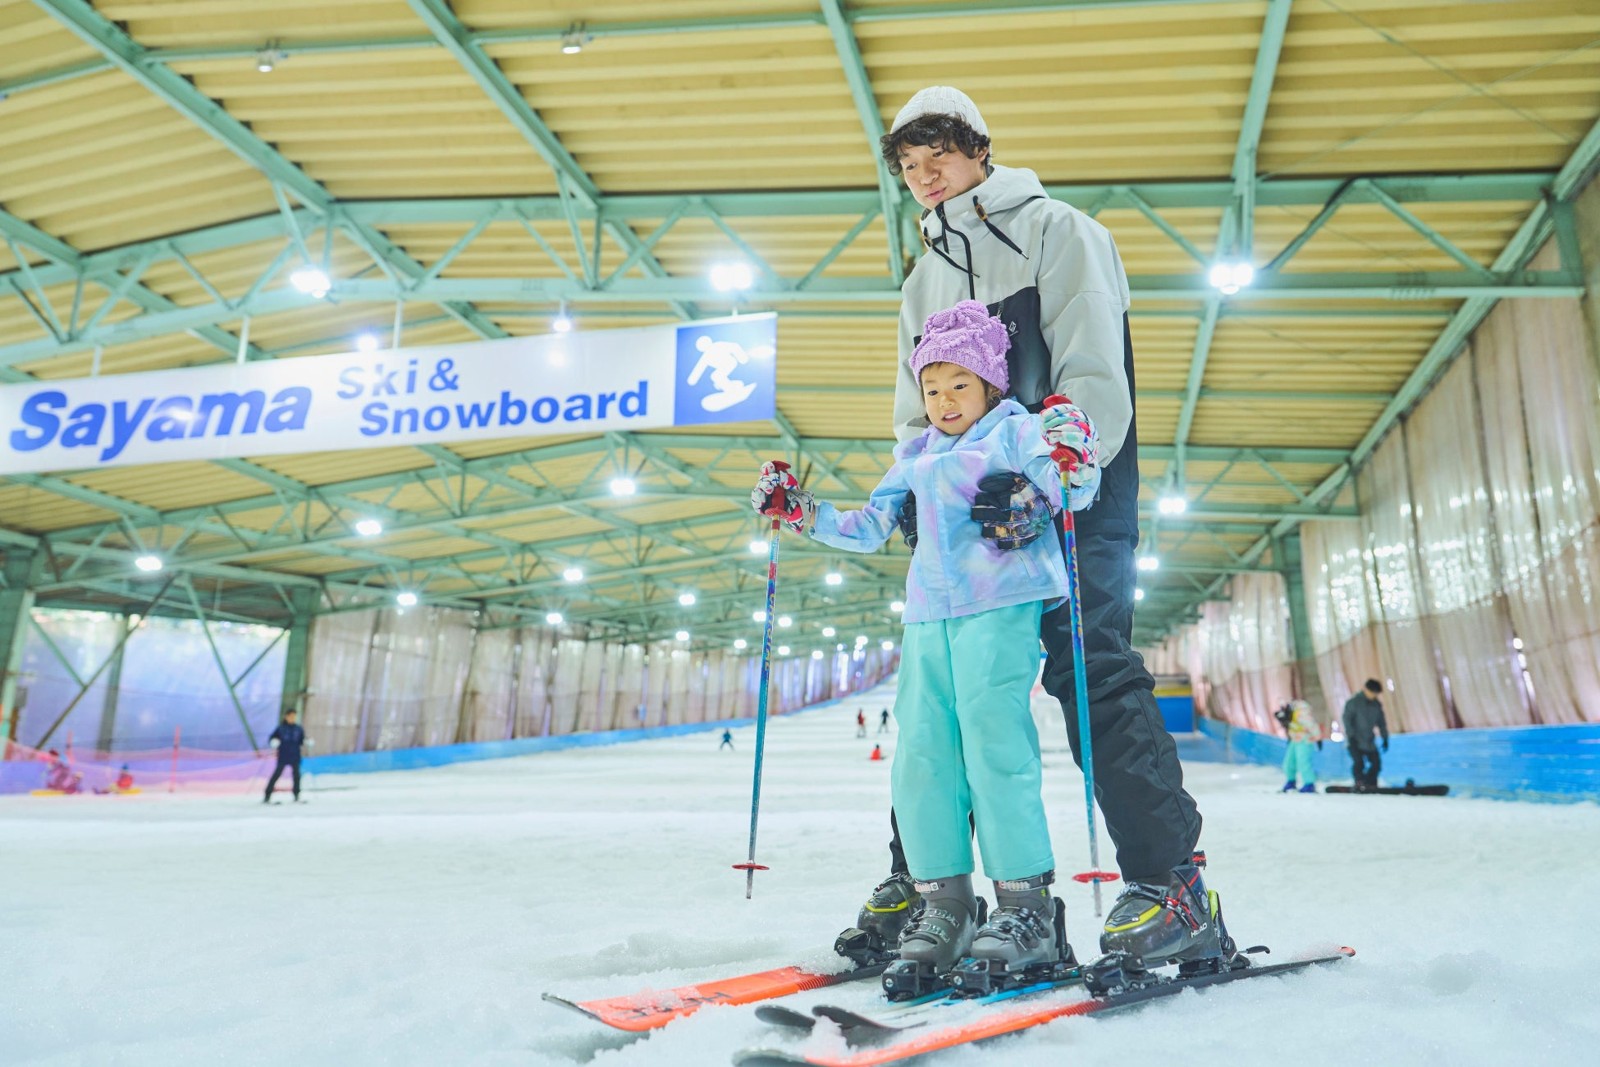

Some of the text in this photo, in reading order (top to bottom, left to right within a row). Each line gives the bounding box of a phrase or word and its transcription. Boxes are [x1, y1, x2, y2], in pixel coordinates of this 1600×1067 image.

[336, 358, 460, 400] Ski &
[10, 386, 312, 461] Sayama
[359, 380, 648, 437] Snowboard
